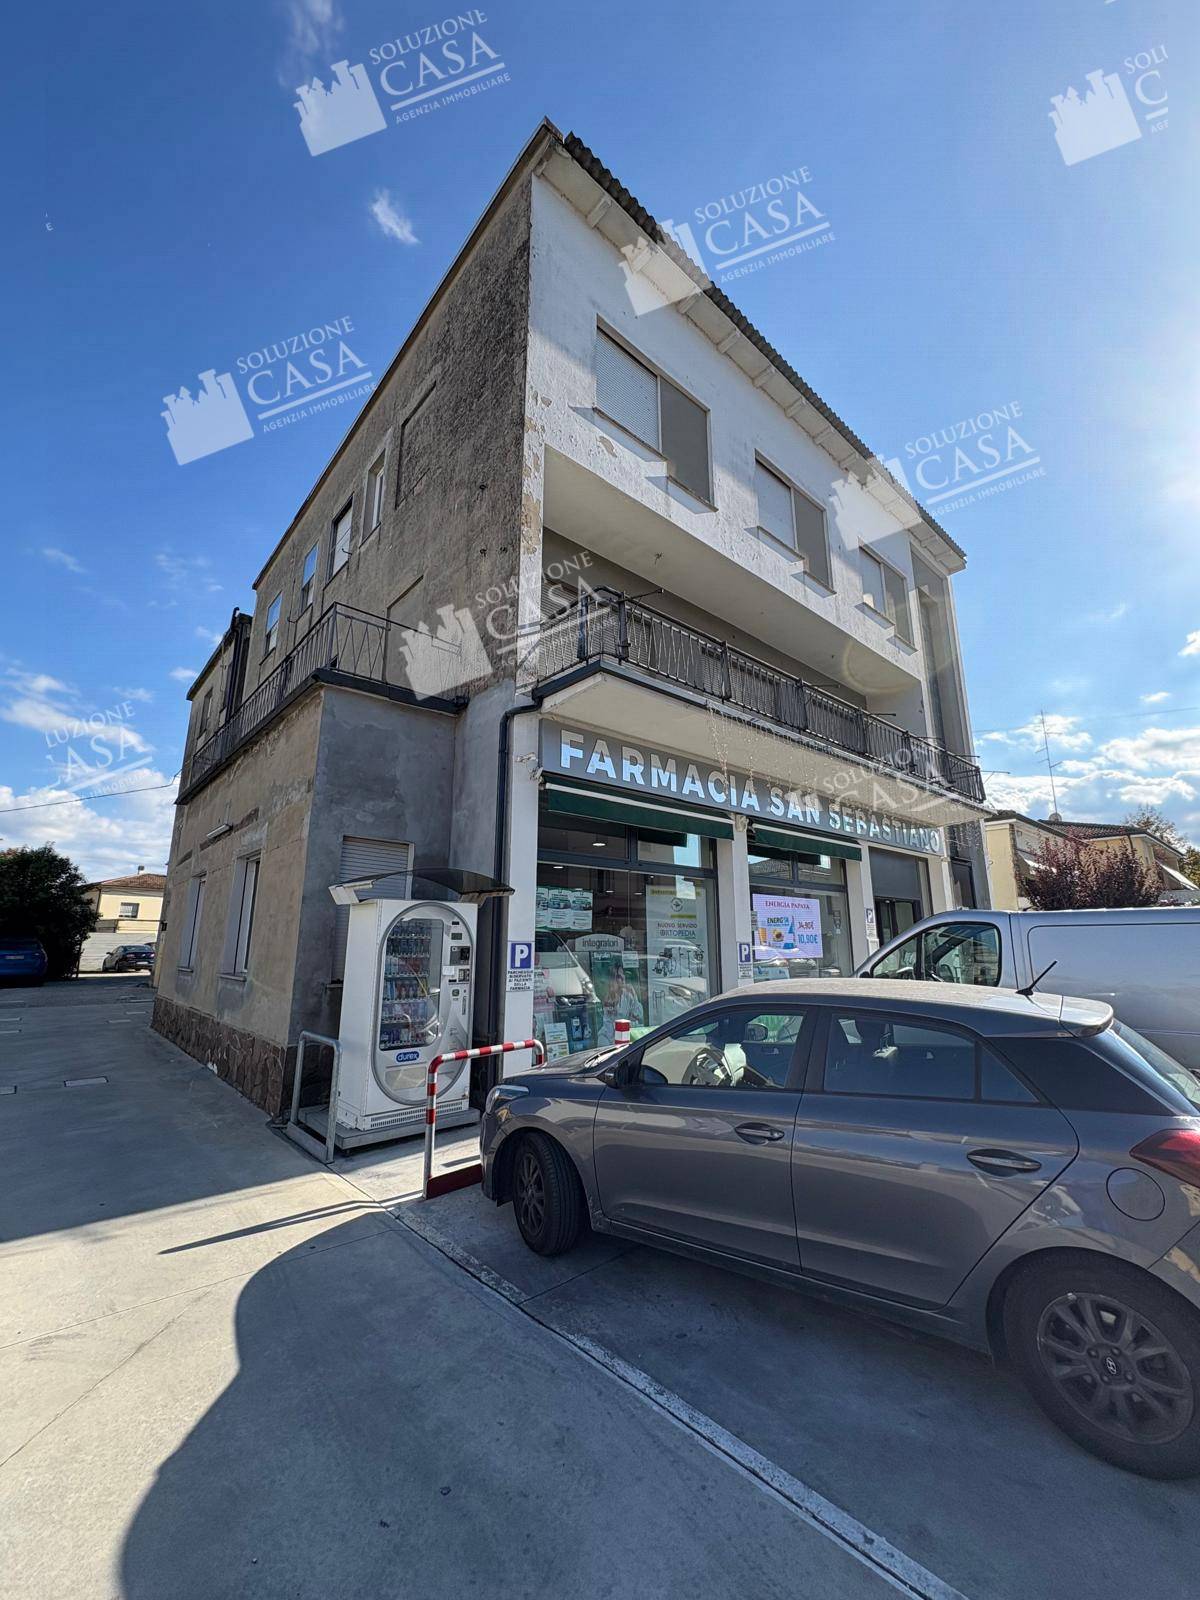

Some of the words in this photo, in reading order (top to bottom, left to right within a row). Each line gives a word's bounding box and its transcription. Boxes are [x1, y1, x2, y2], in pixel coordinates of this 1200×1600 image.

[560, 729, 760, 812] FARMACIA
[770, 786, 821, 825] SAN
[828, 802, 941, 852] SEBASTIANO
[515, 944, 529, 968] P
[741, 944, 750, 961] P
[398, 1052, 418, 1061] durex
